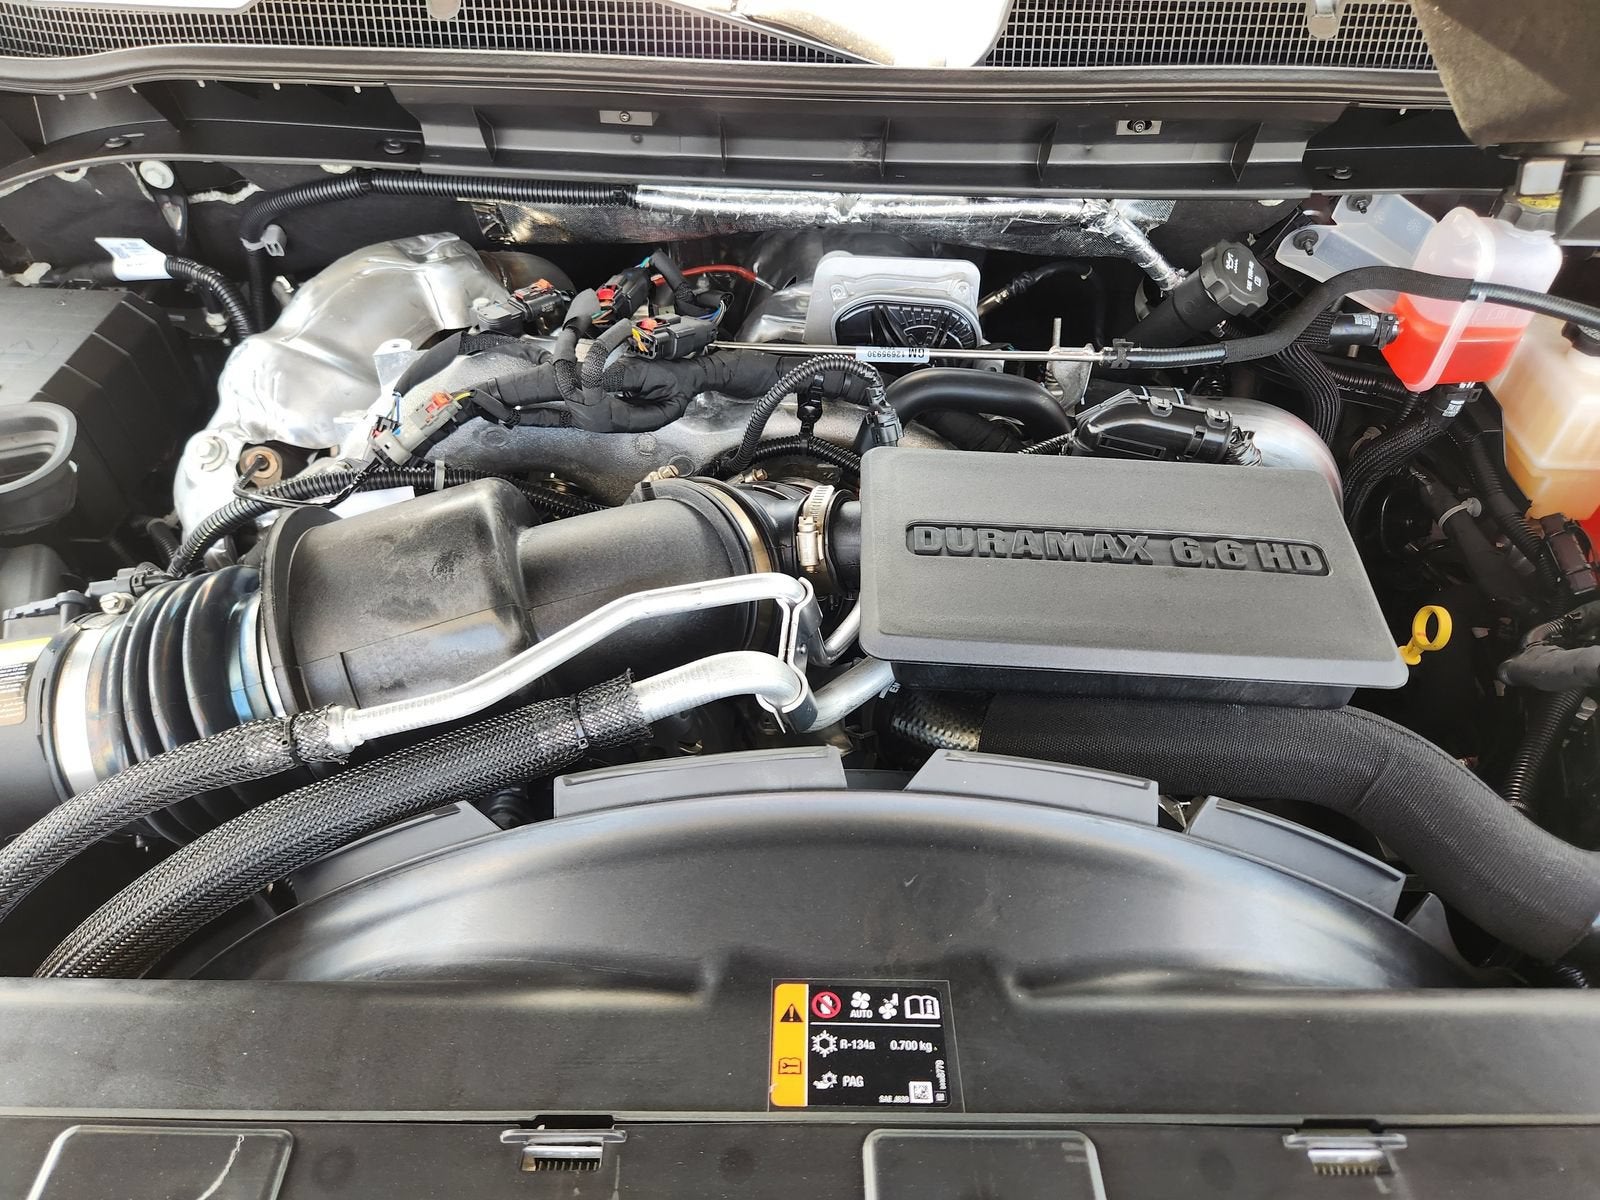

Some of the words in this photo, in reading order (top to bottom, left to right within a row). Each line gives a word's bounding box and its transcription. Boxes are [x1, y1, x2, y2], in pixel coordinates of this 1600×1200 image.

[908, 348, 925, 359] GM
[913, 526, 1154, 565] DURAMAX
[1169, 537, 1248, 569] 6.6
[1255, 542, 1323, 573] HD
[850, 1009, 873, 1019] AUTO
[839, 1039, 876, 1050] R-134a
[889, 1040, 918, 1051] 0.700
[919, 1040, 933, 1053] kg
[842, 1075, 864, 1088] PAG
